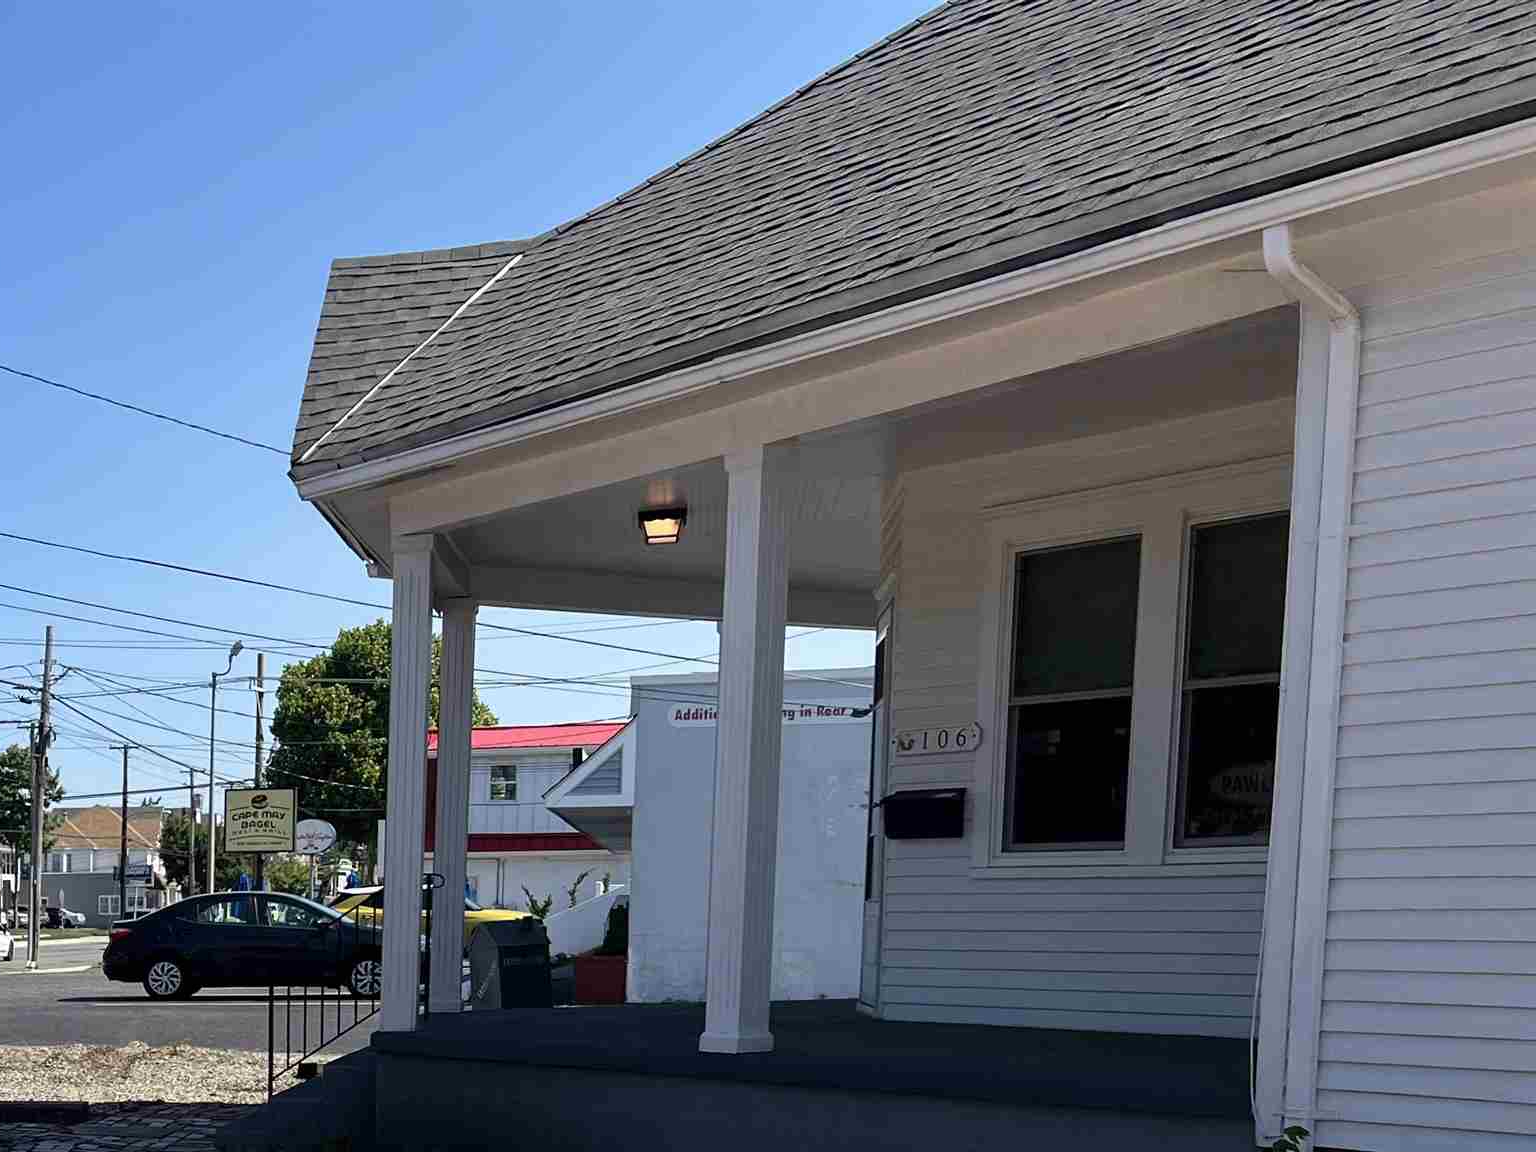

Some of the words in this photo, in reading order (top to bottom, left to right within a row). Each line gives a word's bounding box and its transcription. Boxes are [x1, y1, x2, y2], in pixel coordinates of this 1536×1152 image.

[800, 704, 812, 718] in
[816, 704, 848, 718] Rear
[922, 728, 967, 750] 106
[231, 811, 259, 822] CAPE
[260, 810, 286, 820] MAY
[240, 820, 276, 829] BAGEL
